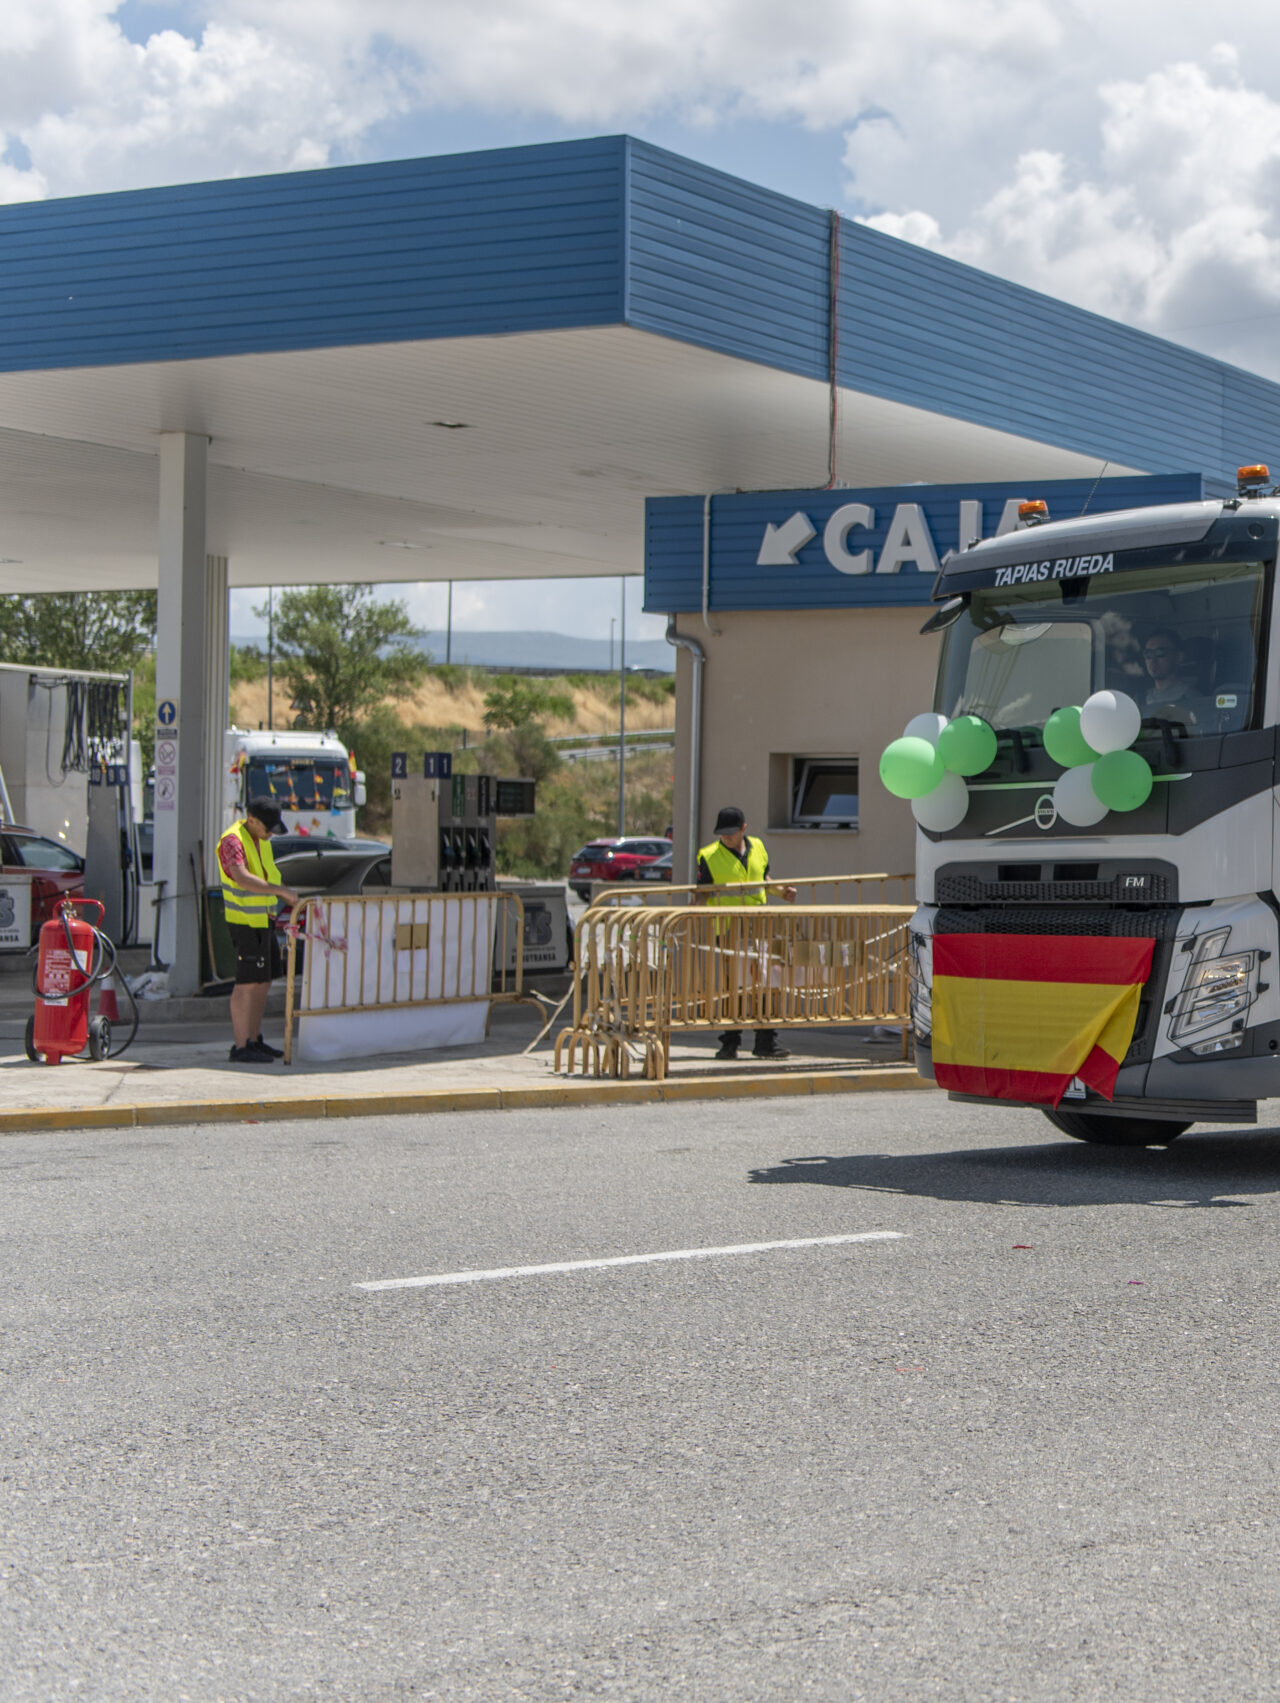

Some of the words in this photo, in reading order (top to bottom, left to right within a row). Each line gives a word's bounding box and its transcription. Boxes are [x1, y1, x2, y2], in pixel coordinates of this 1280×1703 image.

[994, 562, 1050, 587] TAPIAS
[1052, 553, 1114, 579] RUEDA
[395, 757, 403, 774] 2
[429, 757, 435, 774] 1
[442, 757, 448, 774] 1
[1125, 877, 1144, 887] FM
